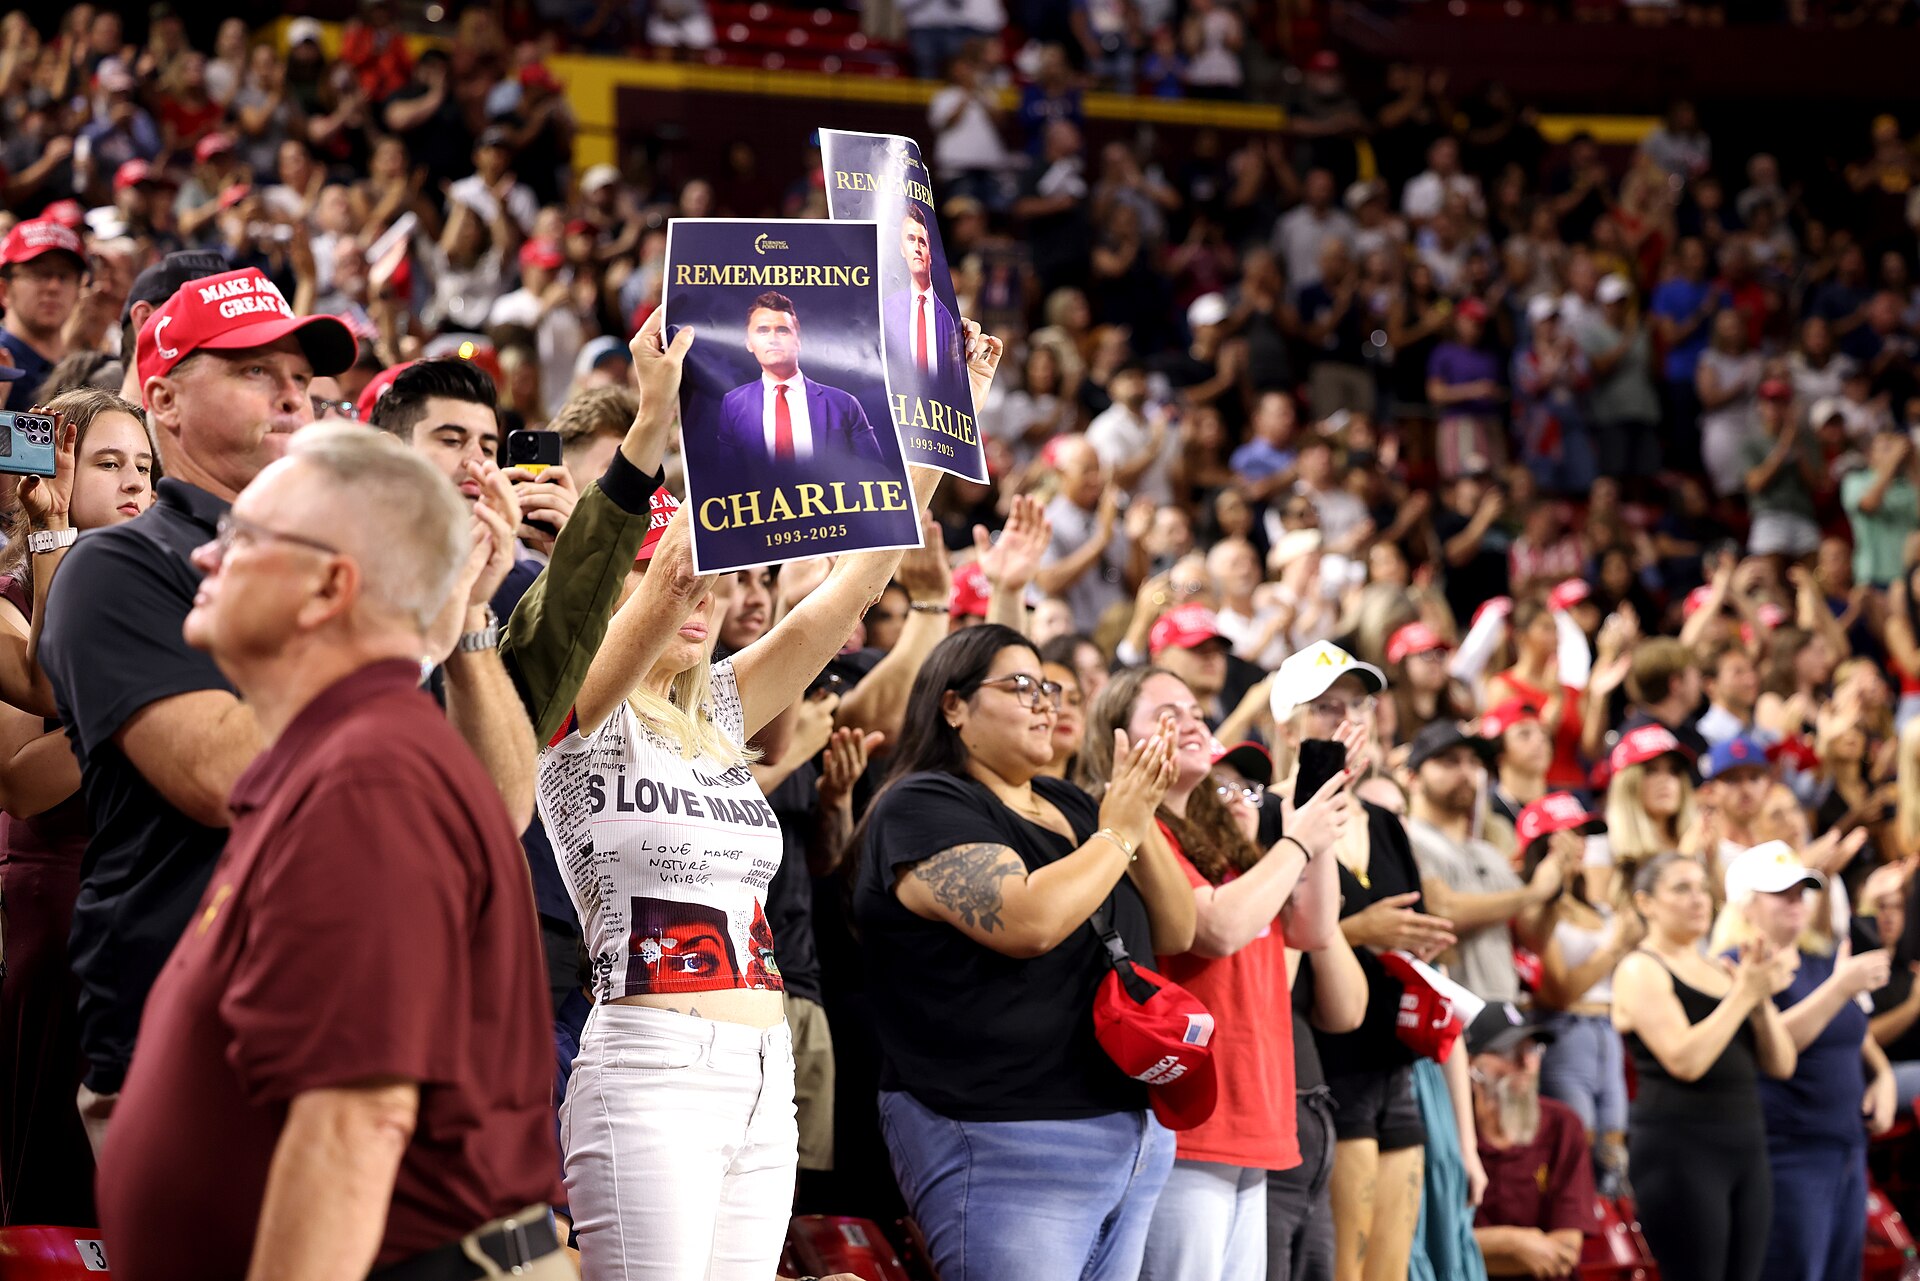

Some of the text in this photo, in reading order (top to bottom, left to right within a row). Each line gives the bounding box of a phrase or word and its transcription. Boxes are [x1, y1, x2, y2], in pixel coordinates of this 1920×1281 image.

[675, 264, 871, 287] REMEMBERING
[198, 277, 255, 304] MAKE
[219, 295, 278, 319] GREAT
[890, 393, 977, 446] HARLIE
[910, 437, 955, 458] 1993-2025
[699, 481, 908, 532] CHARLIE
[765, 524, 848, 547] 1993-2025
[617, 775, 704, 818] LOVE
[704, 795, 778, 829] MADE
[641, 840, 743, 860] LOVE MAKES
[649, 858, 710, 871] NATURE
